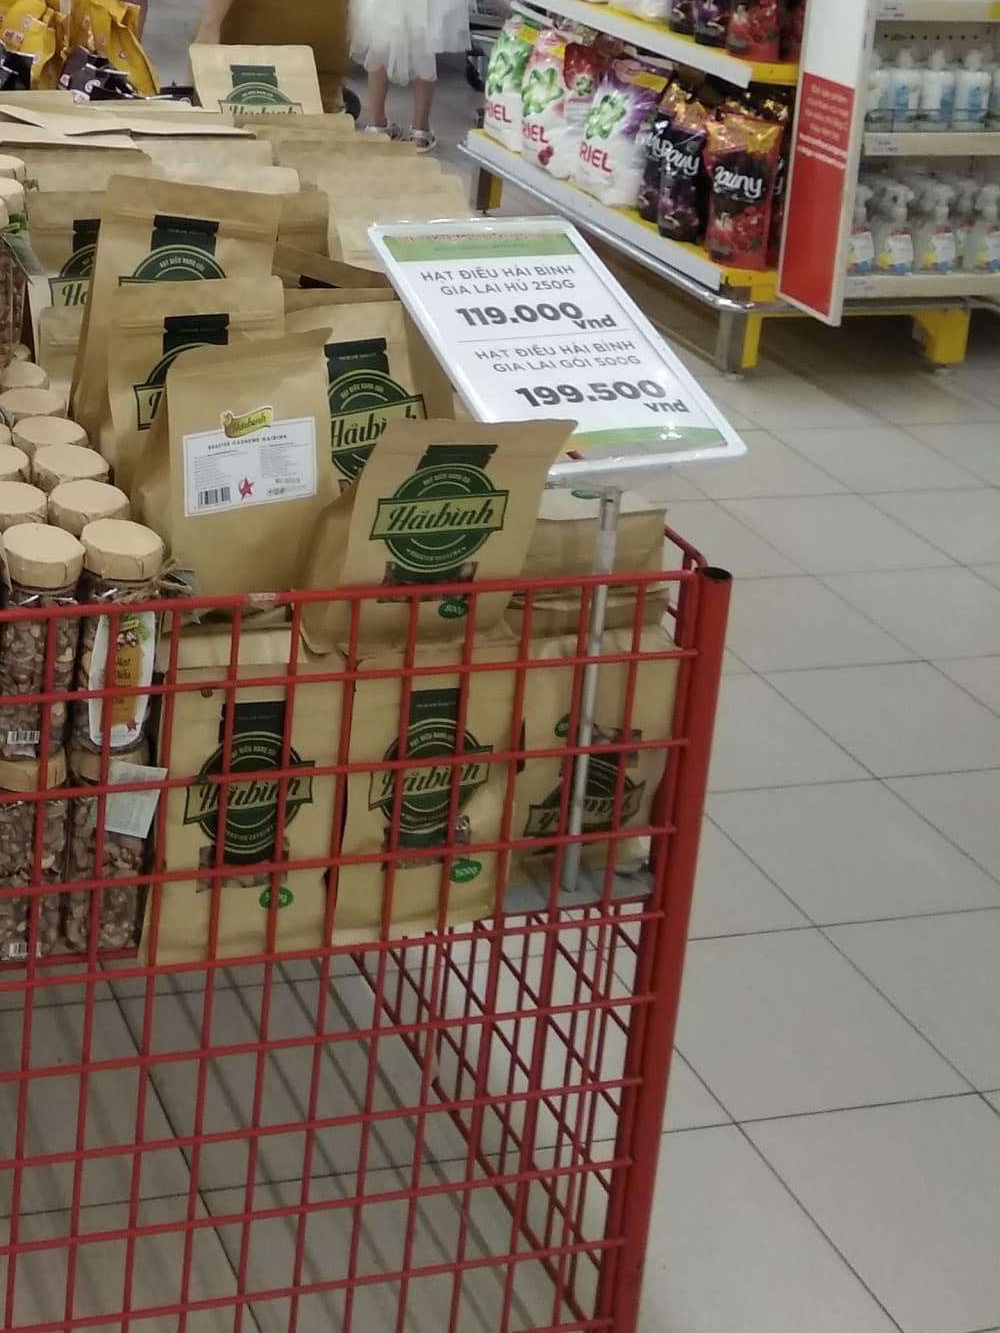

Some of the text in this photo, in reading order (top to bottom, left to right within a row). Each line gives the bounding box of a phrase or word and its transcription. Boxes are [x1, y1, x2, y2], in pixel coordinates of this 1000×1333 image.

[580, 141, 612, 172] RIEL
[420, 271, 455, 285] HẠT
[458, 266, 498, 280] ĐIỀU
[536, 262, 576, 276] BÌNH
[440, 285, 472, 296] GIA
[473, 283, 501, 294] LAI
[532, 278, 576, 290] 250G
[456, 301, 583, 327] 119.000
[572, 314, 617, 330] vnd
[475, 348, 510, 361] HẠT
[514, 343, 556, 357] ĐIỀU
[593, 340, 636, 353] BÌNH
[493, 362, 525, 373] GIA
[527, 360, 557, 370] LAI
[594, 355, 641, 367] 500G
[514, 379, 666, 407] 199.500
[644, 399, 689, 413] vnd
